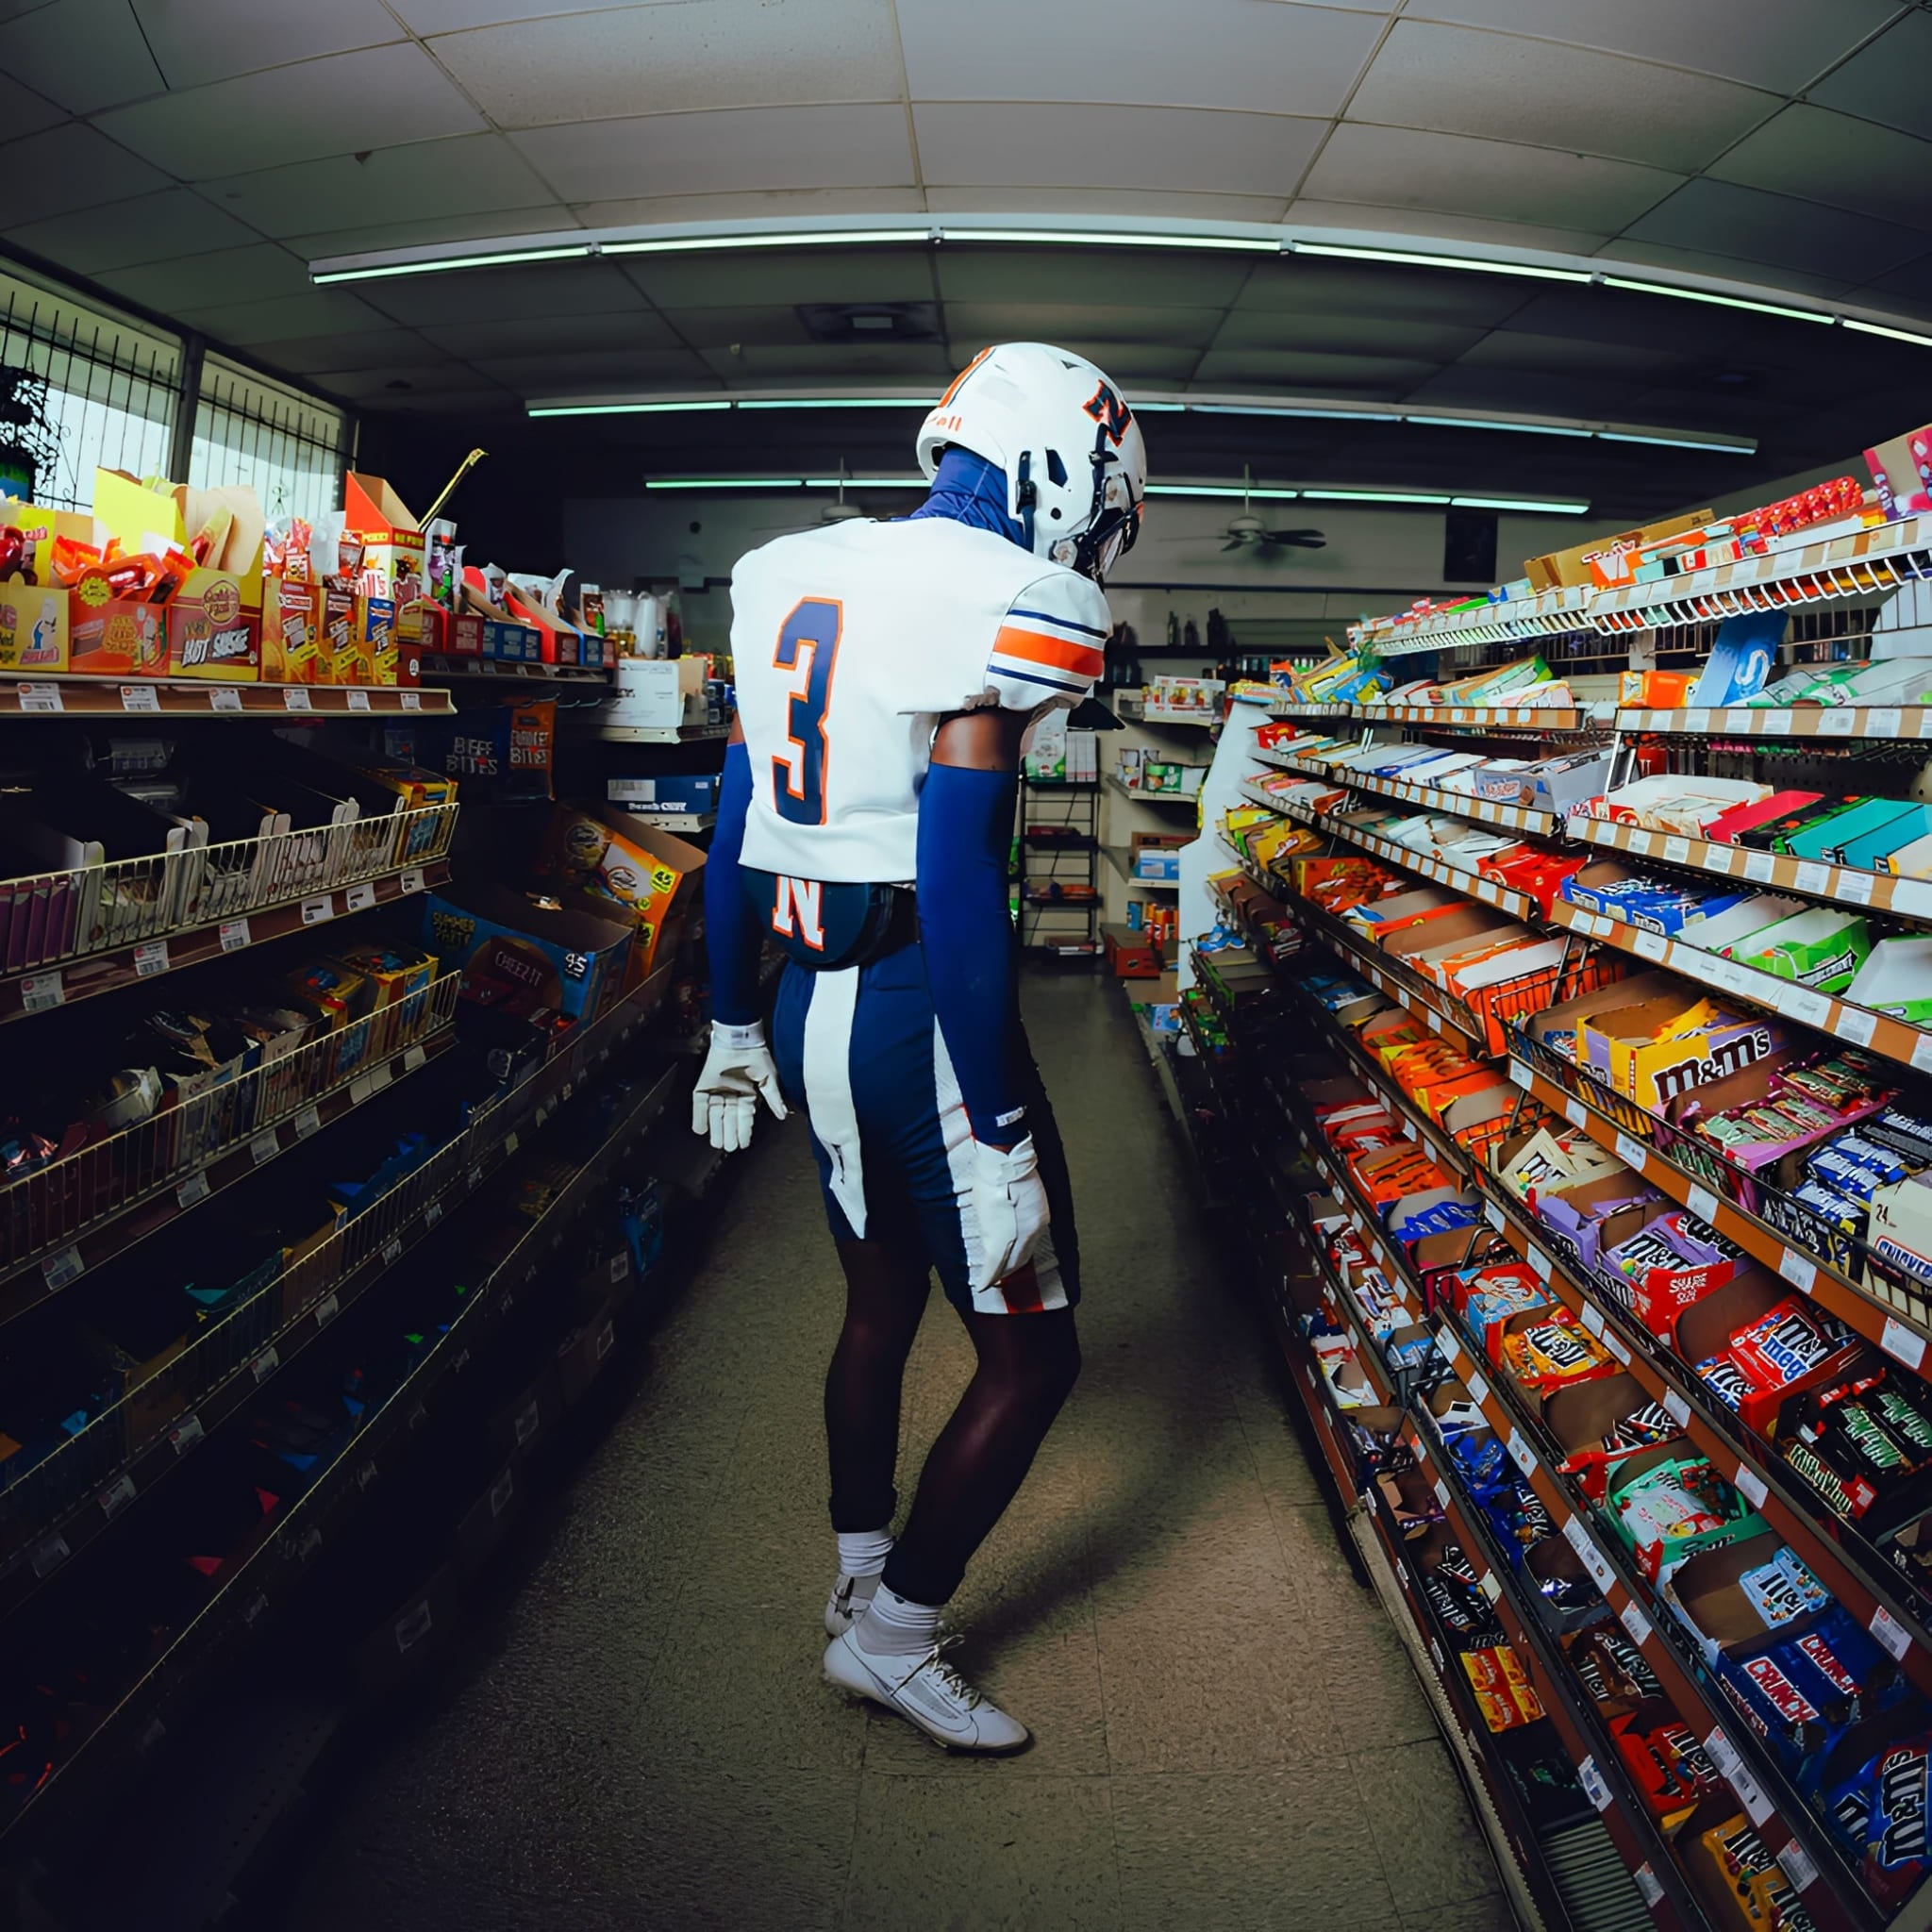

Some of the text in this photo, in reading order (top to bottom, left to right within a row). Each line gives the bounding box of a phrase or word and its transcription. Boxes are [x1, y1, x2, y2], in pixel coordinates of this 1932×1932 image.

[773, 596, 843, 825] 3
[772, 874, 824, 952] N
[1741, 1656, 1820, 1723] CRUNCH
